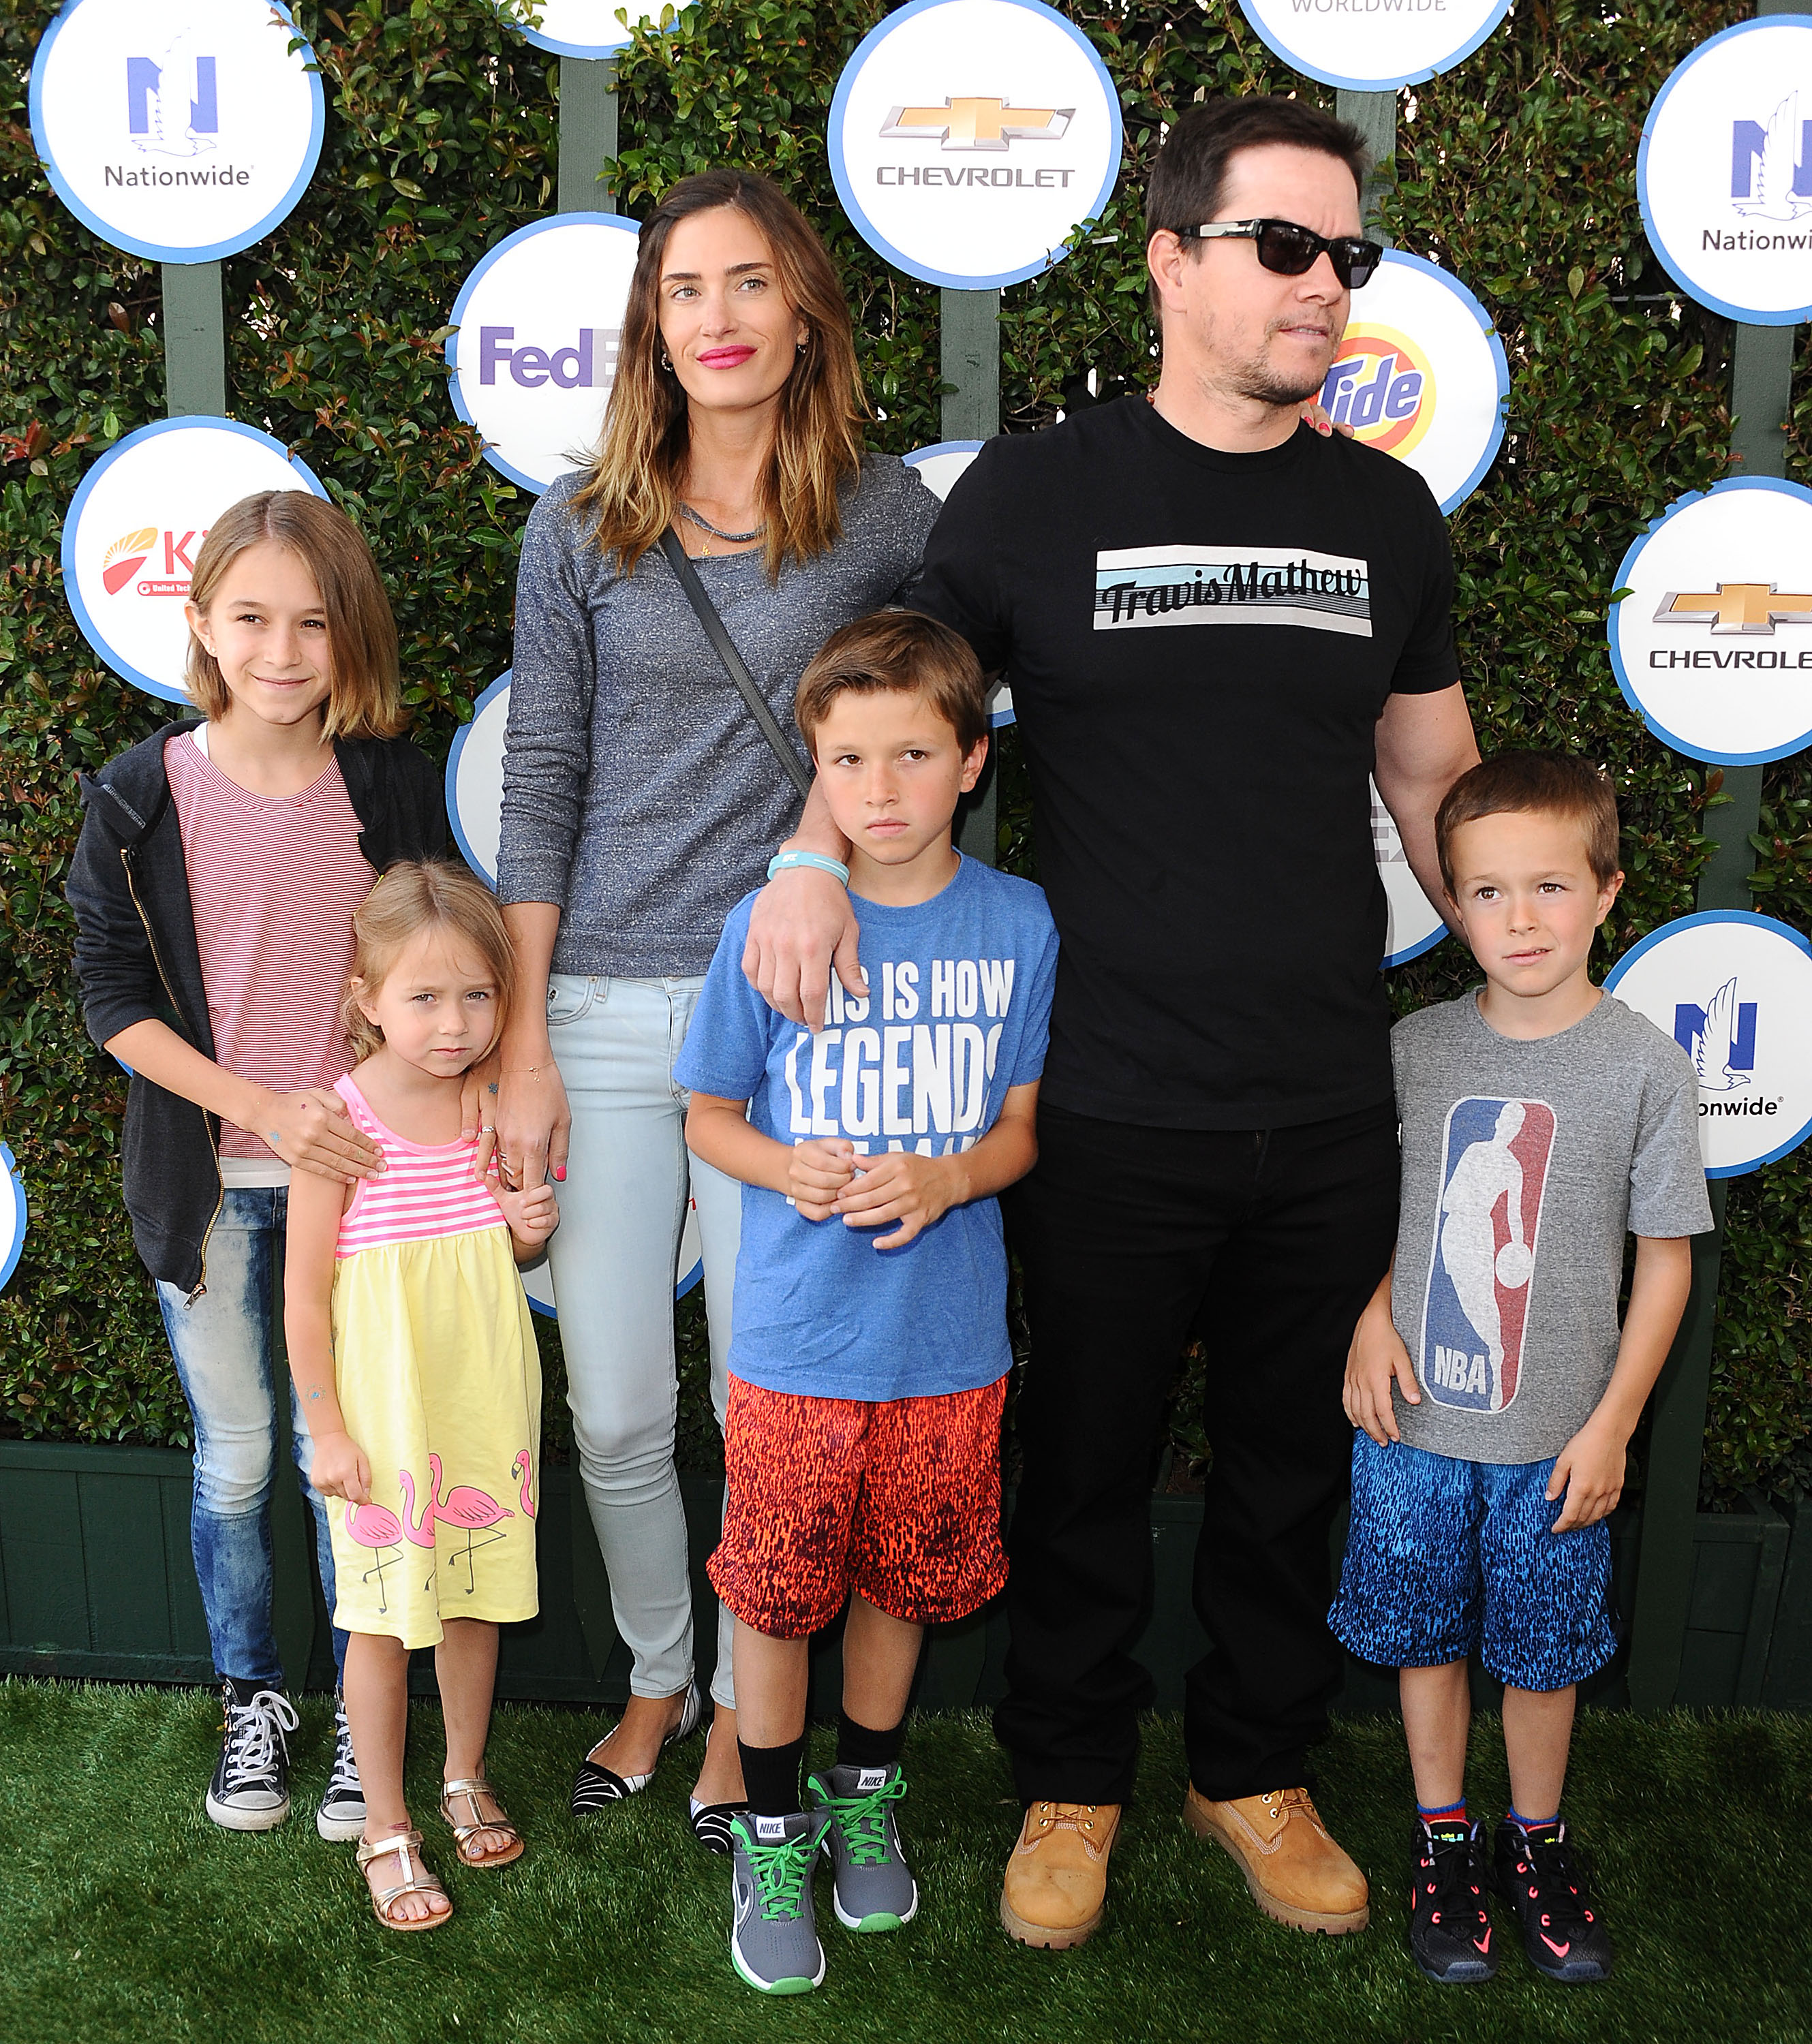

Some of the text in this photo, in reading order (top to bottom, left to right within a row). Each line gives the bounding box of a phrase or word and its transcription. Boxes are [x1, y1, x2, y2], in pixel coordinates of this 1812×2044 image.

[1292, 0, 1446, 12] WORLDWIDE
[104, 165, 250, 187] Nationwide
[877, 167, 1075, 188] CHEVROLET
[1702, 229, 1812, 251] Nationwi
[480, 326, 621, 389] FedE
[1319, 356, 1423, 428] Tide
[1649, 650, 1812, 669] CHEVROLE
[882, 961, 919, 1021] IS
[932, 959, 1015, 1018] HOW
[1434, 1345, 1487, 1395] NBA
[861, 1775, 885, 1788] NIKE
[759, 1823, 782, 1835] NIKE
